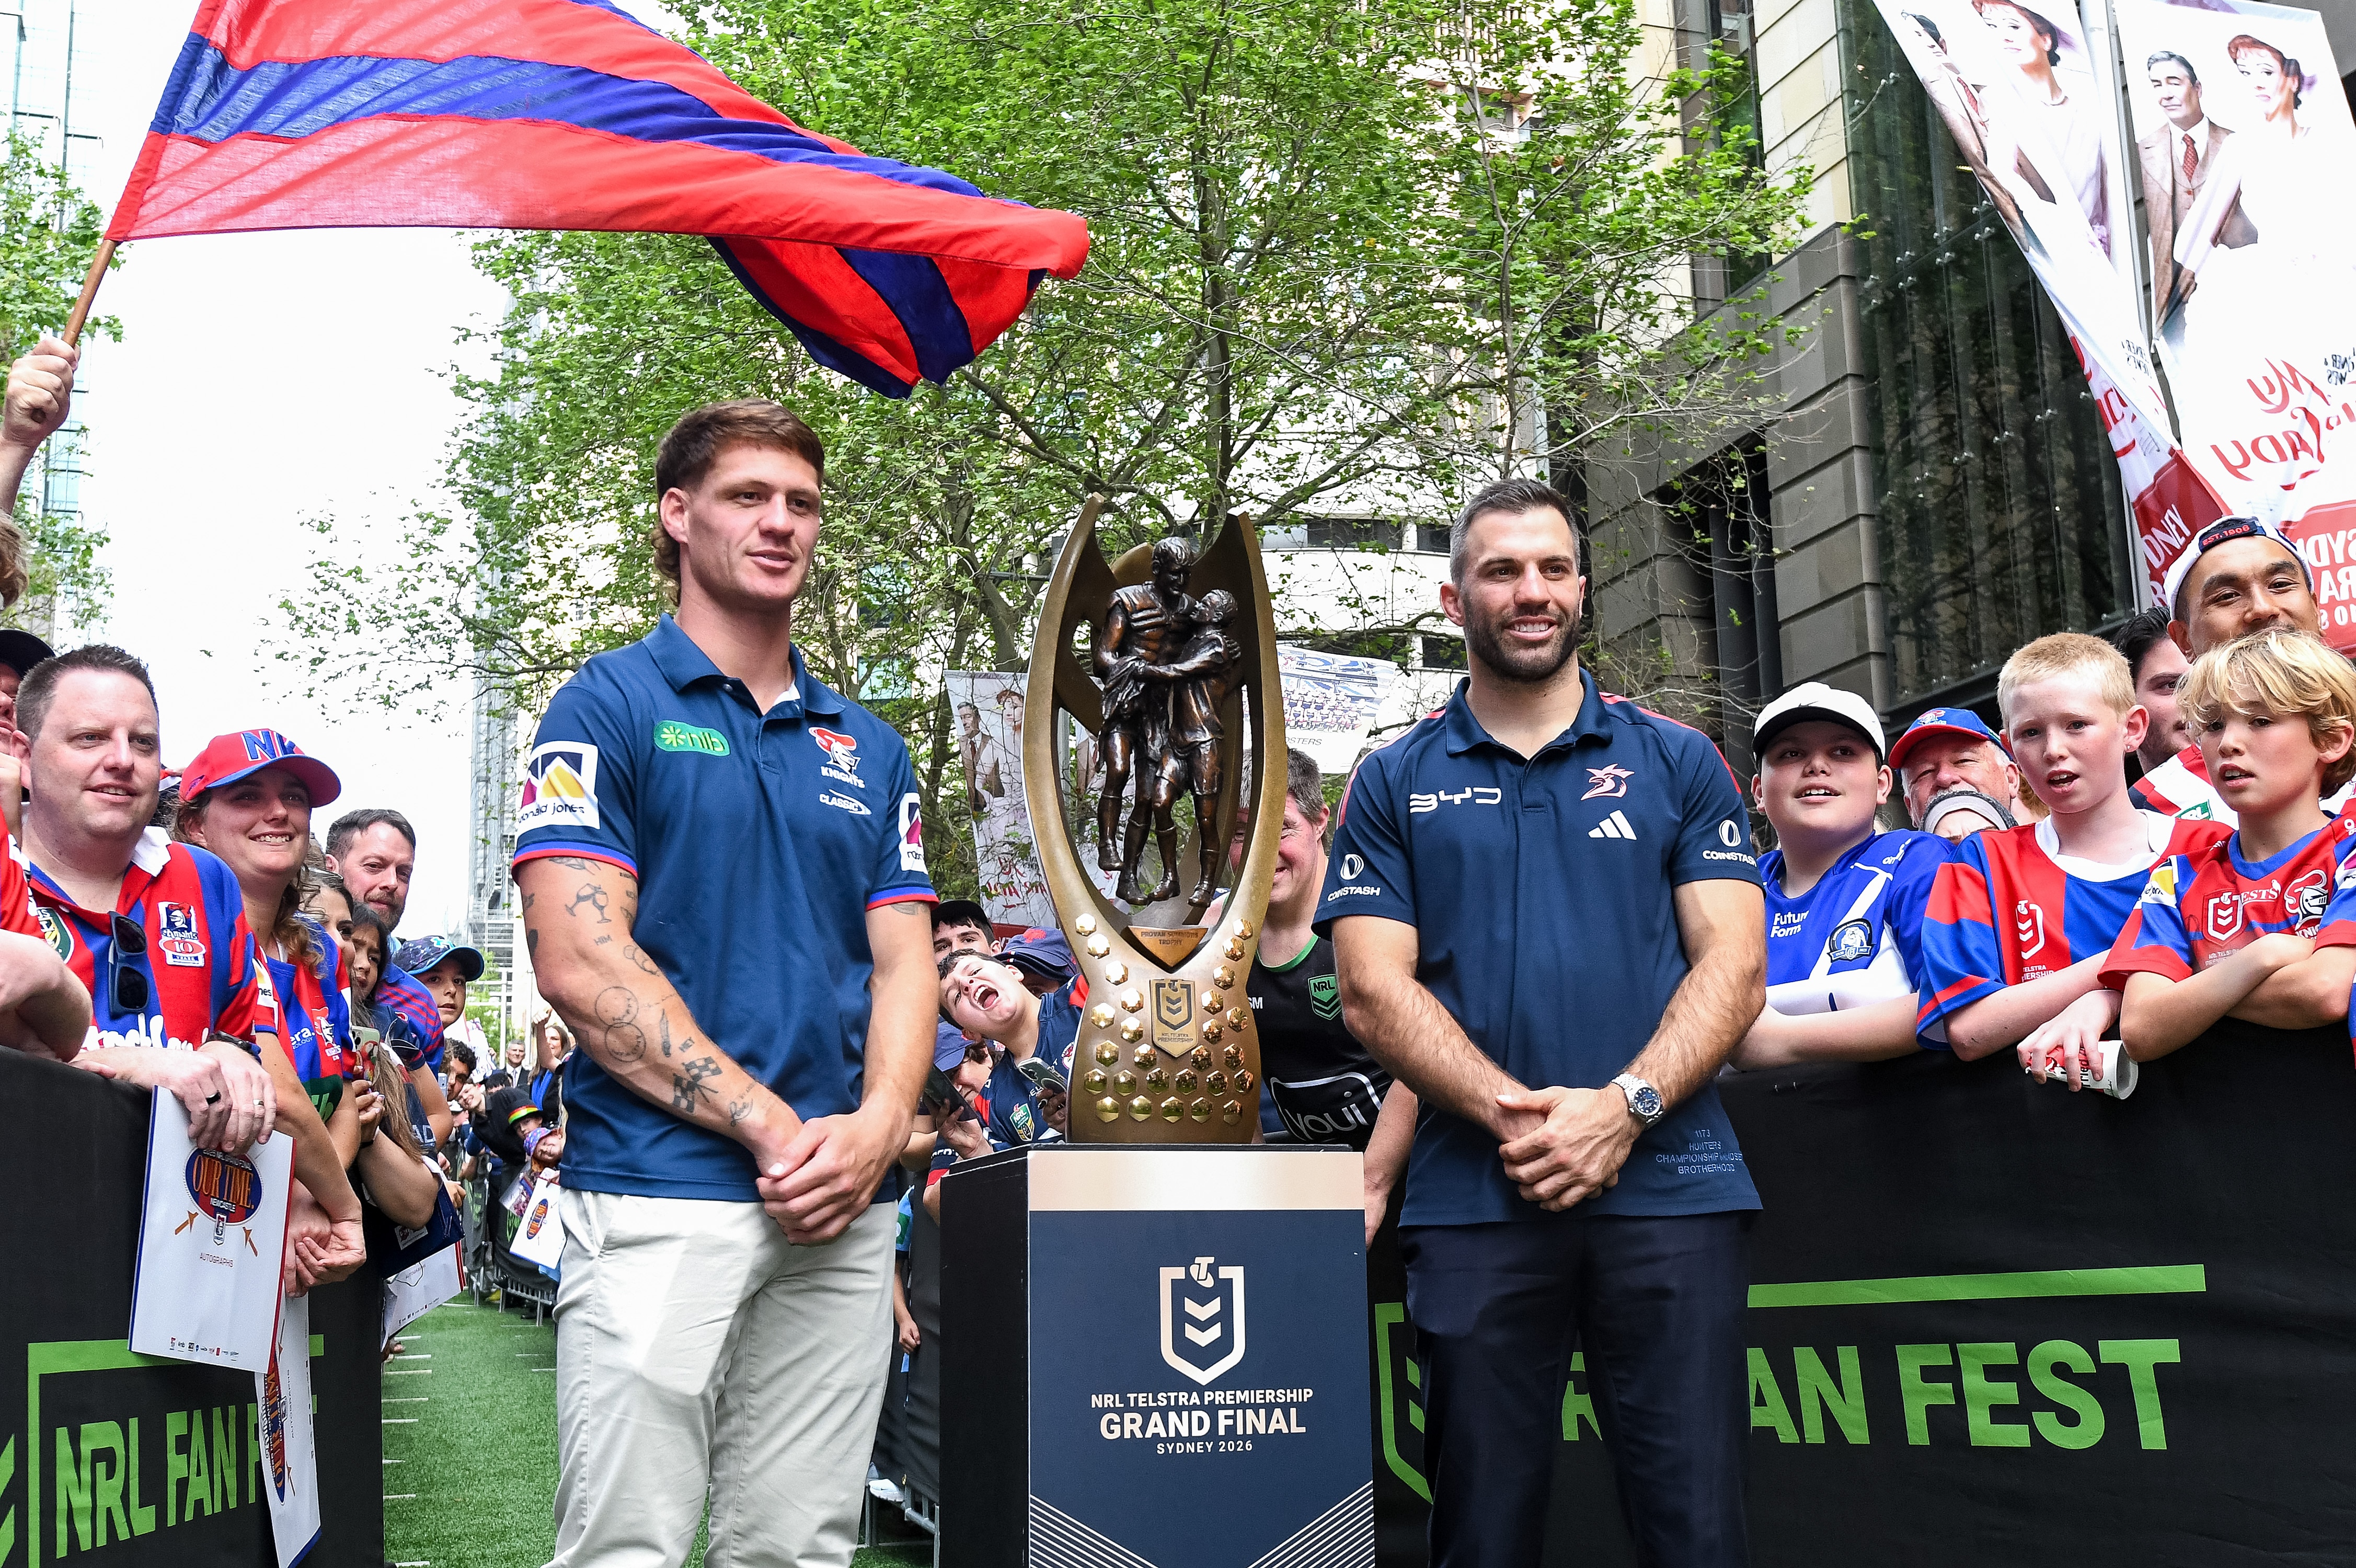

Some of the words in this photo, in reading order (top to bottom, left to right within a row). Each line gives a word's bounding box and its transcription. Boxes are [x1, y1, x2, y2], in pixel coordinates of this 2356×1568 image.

[686, 732, 726, 752] nib
[820, 766, 866, 788] KNIGHTS
[551, 802, 585, 815] jones
[819, 793, 859, 812] CLASSIC
[1702, 850, 1757, 868] COINSTASH
[1327, 886, 1381, 902] COINSTASH
[2242, 887, 2279, 905] ESTS
[173, 941, 194, 953] 10
[1313, 981, 1336, 993] NRL
[1013, 1109, 1027, 1123] NRL
[1695, 1129, 1711, 1138] 1173
[1689, 1141, 1722, 1151] HUNTERS
[1656, 1152, 1719, 1163] CHAMPIONSHIP
[192, 1155, 222, 1198] OUR
[1678, 1163, 1735, 1174] BROTHERHOOD
[1091, 1394, 1124, 1409] NRL
[1127, 1391, 1201, 1407] TELSTRA
[1203, 1388, 1314, 1405] PREMIERSHIP
[1748, 1345, 1870, 1445] AN
[1894, 1338, 2181, 1450] FEST
[1100, 1410, 1211, 1440] GRAND
[1217, 1407, 1306, 1436] FINAL
[1156, 1442, 1214, 1455] SYDNEY
[1218, 1439, 1253, 1452] 2026
[56, 1417, 156, 1559] NRL
[166, 1405, 237, 1527] FAN
